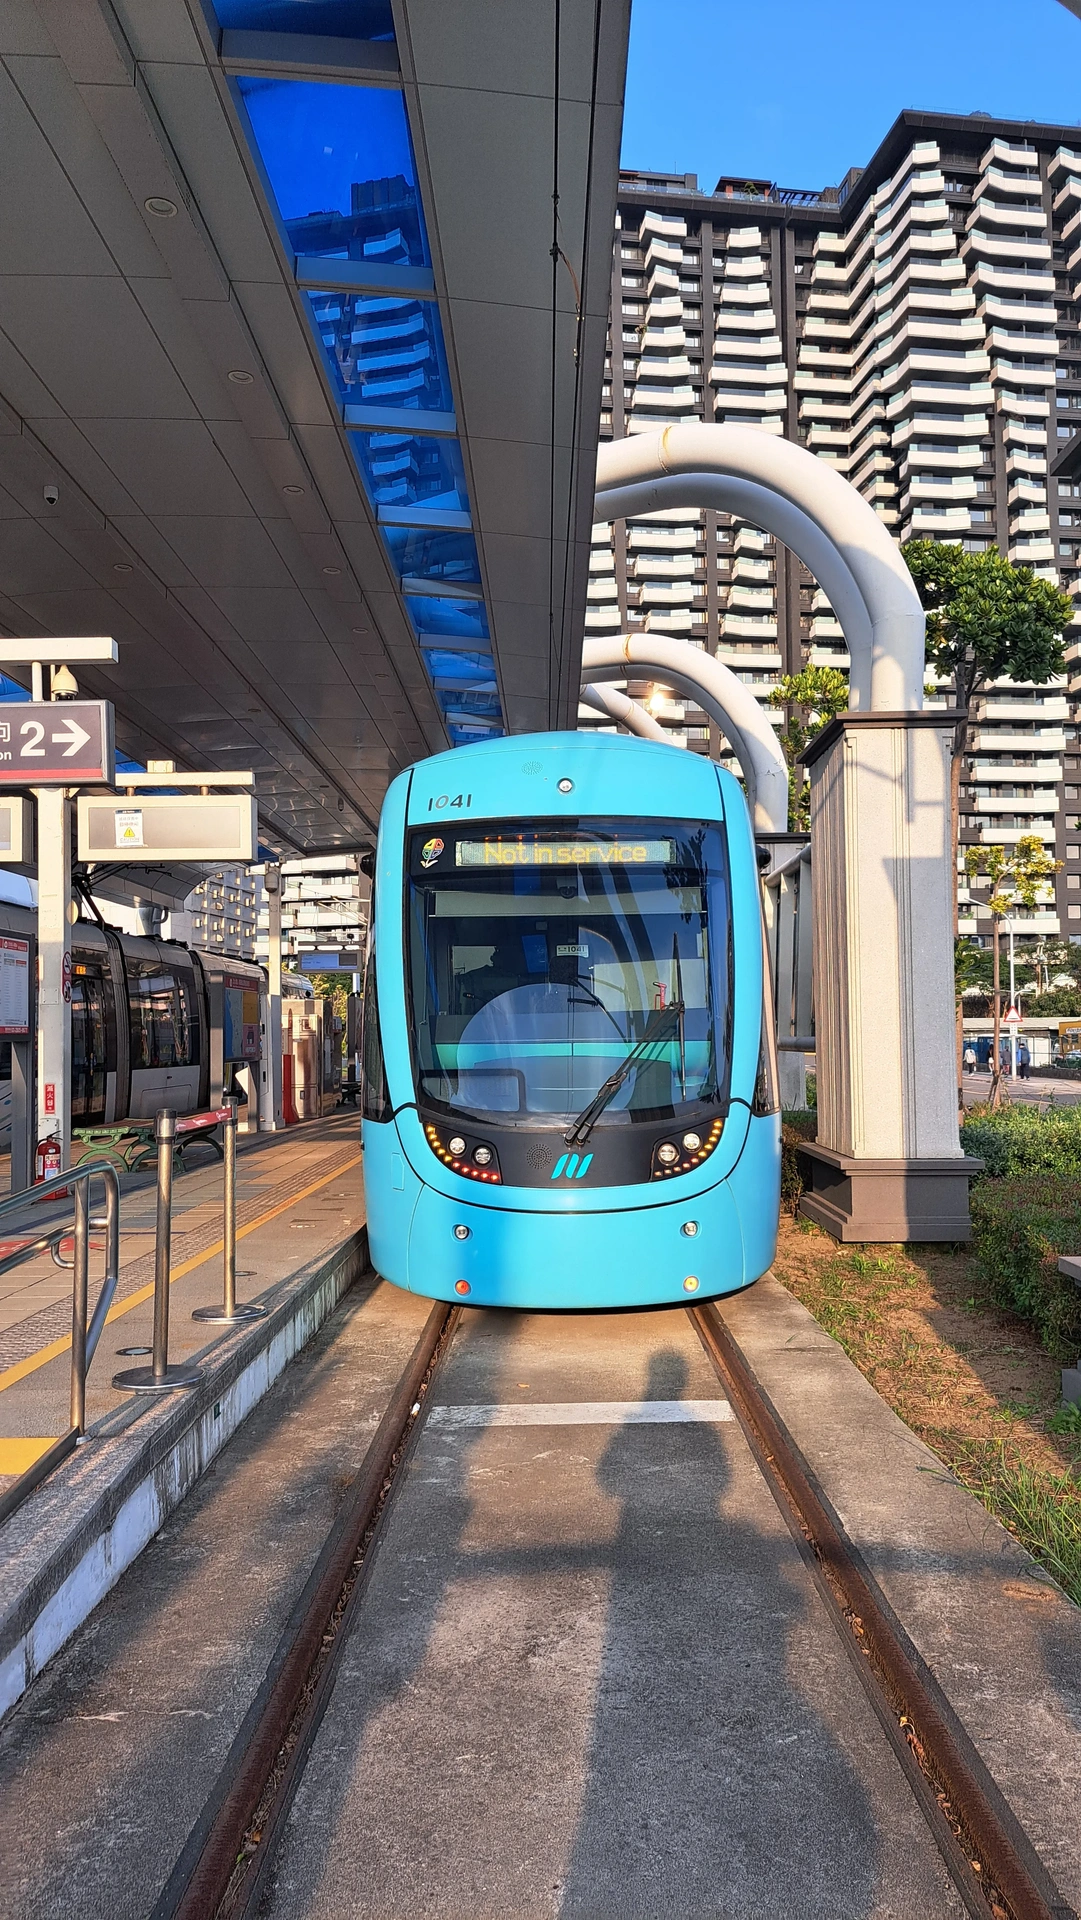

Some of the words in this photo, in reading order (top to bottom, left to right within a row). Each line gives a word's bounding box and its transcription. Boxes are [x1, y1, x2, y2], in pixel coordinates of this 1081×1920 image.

[20, 720, 46, 757] 2
[427, 793, 472, 812] 1041
[484, 842, 529, 865] Not
[533, 842, 553, 865] in
[557, 841, 647, 864] service
[567, 945, 585, 953] 1041
